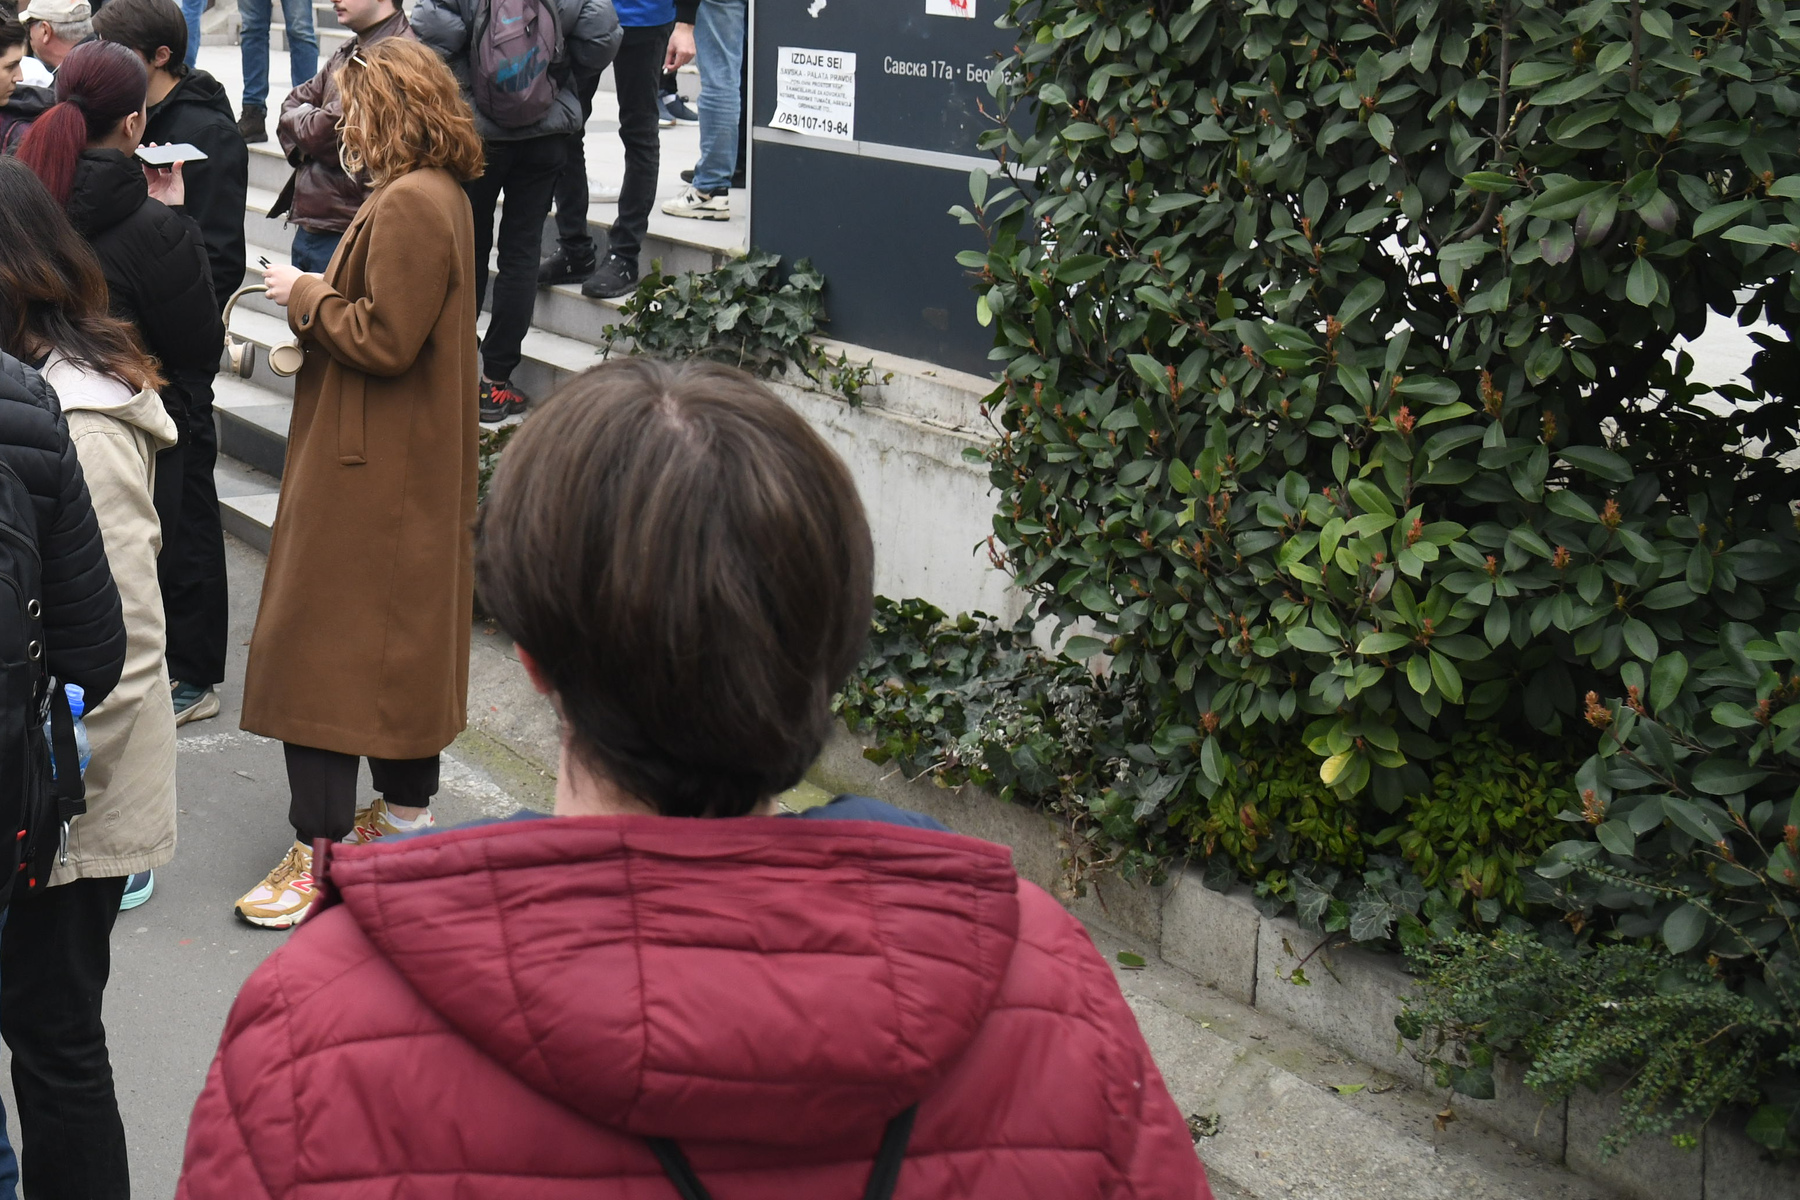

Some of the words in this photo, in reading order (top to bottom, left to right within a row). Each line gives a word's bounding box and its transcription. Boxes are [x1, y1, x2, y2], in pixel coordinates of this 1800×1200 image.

[791, 53, 824, 67] IZDAJE
[780, 67, 802, 76] SAVSKA
[807, 71, 829, 80] PALATA
[830, 73, 853, 83] PRAVDE
[884, 56, 927, 78] Савска
[931, 60, 953, 80] 17а
[966, 64, 1020, 86] Беоа
